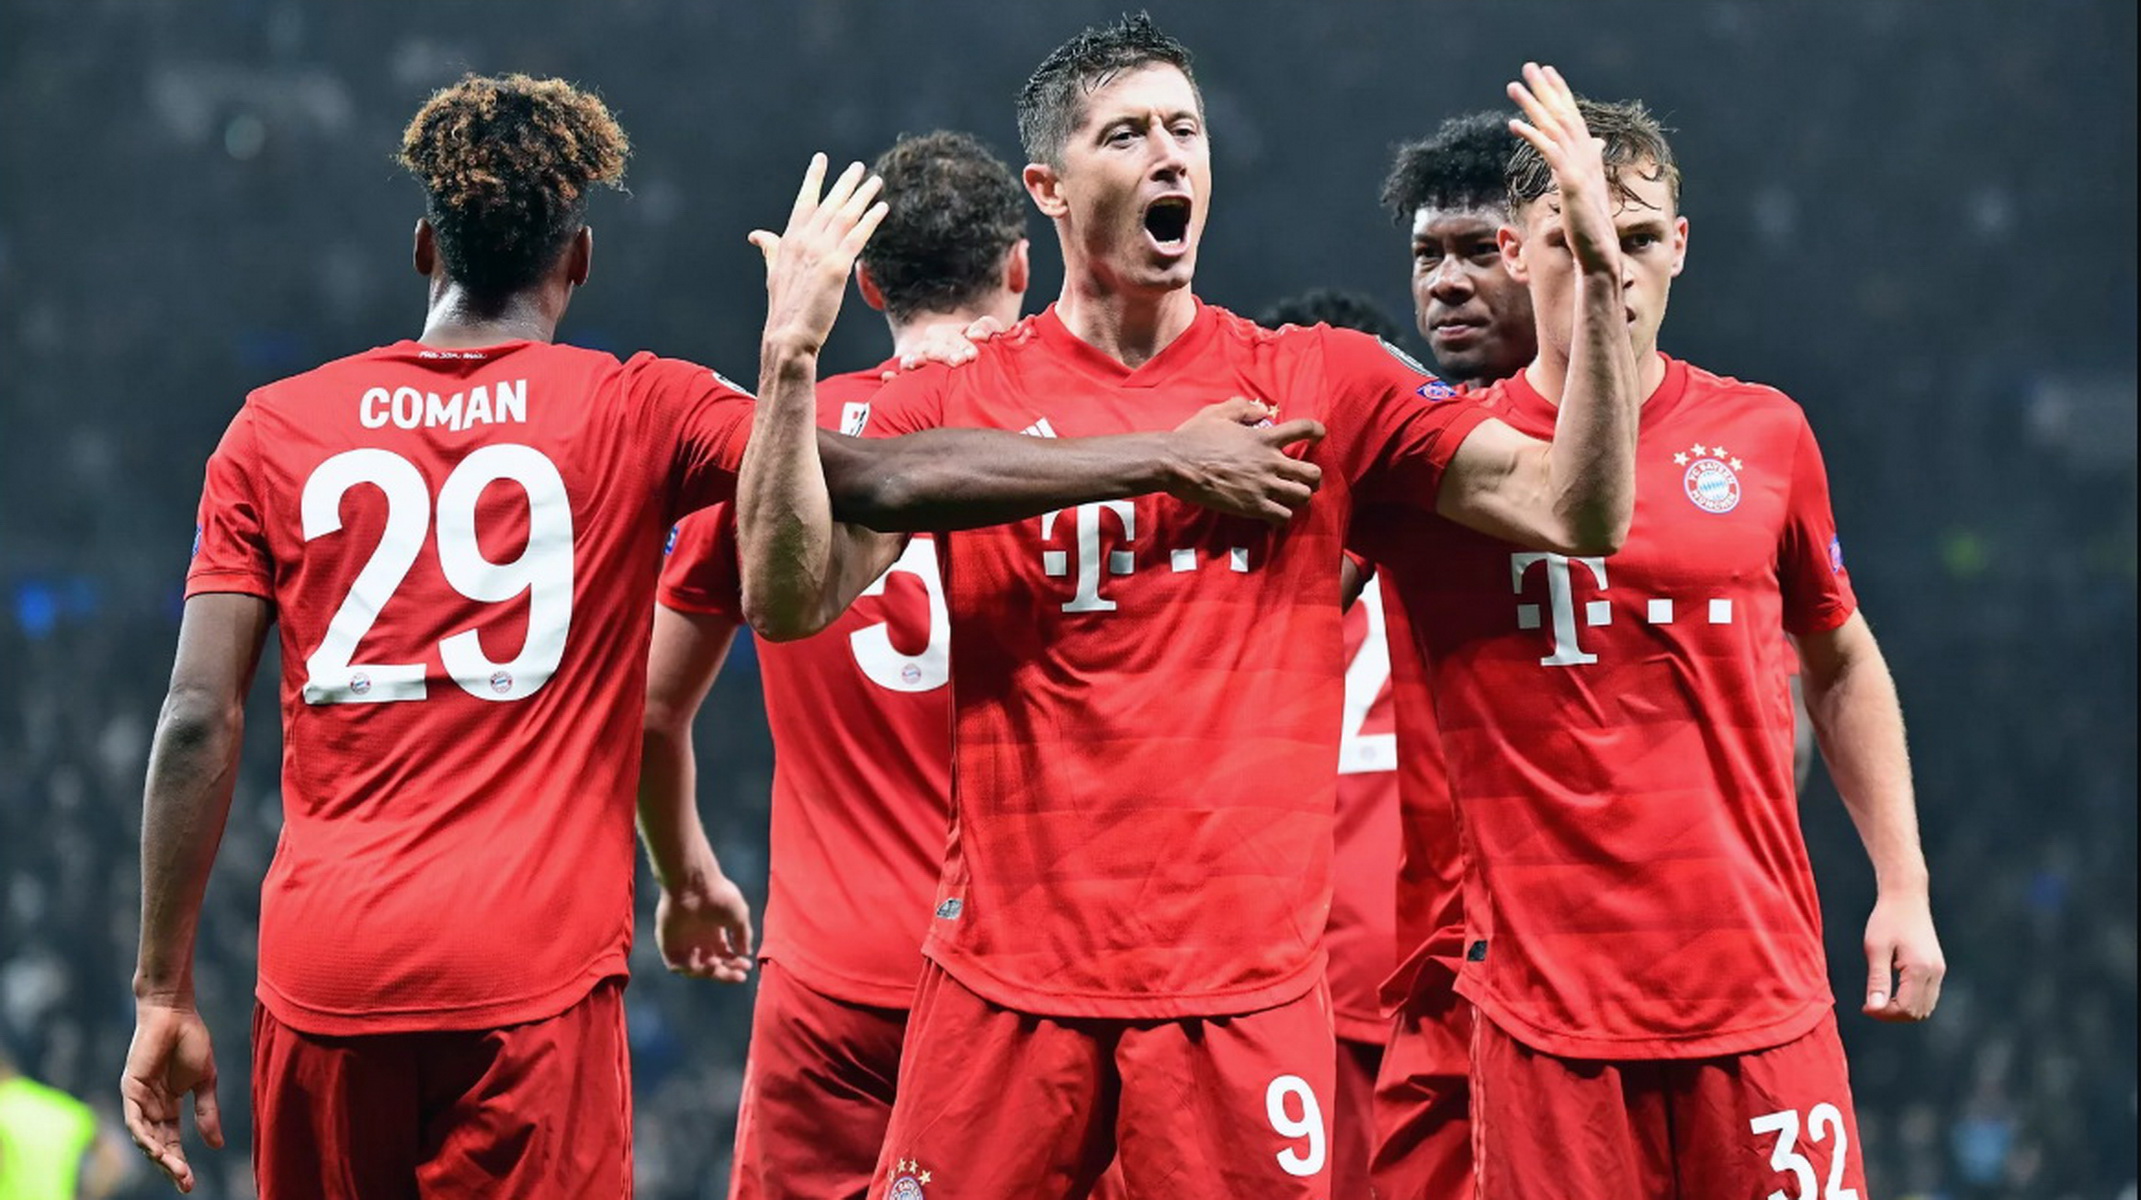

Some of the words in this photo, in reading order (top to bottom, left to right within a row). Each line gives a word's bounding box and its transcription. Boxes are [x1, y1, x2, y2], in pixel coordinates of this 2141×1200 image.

[360, 379, 527, 431] COMAN
[301, 443, 574, 704] 29
[1265, 1074, 1326, 1176] 9
[1750, 1102, 1859, 1200] 32
